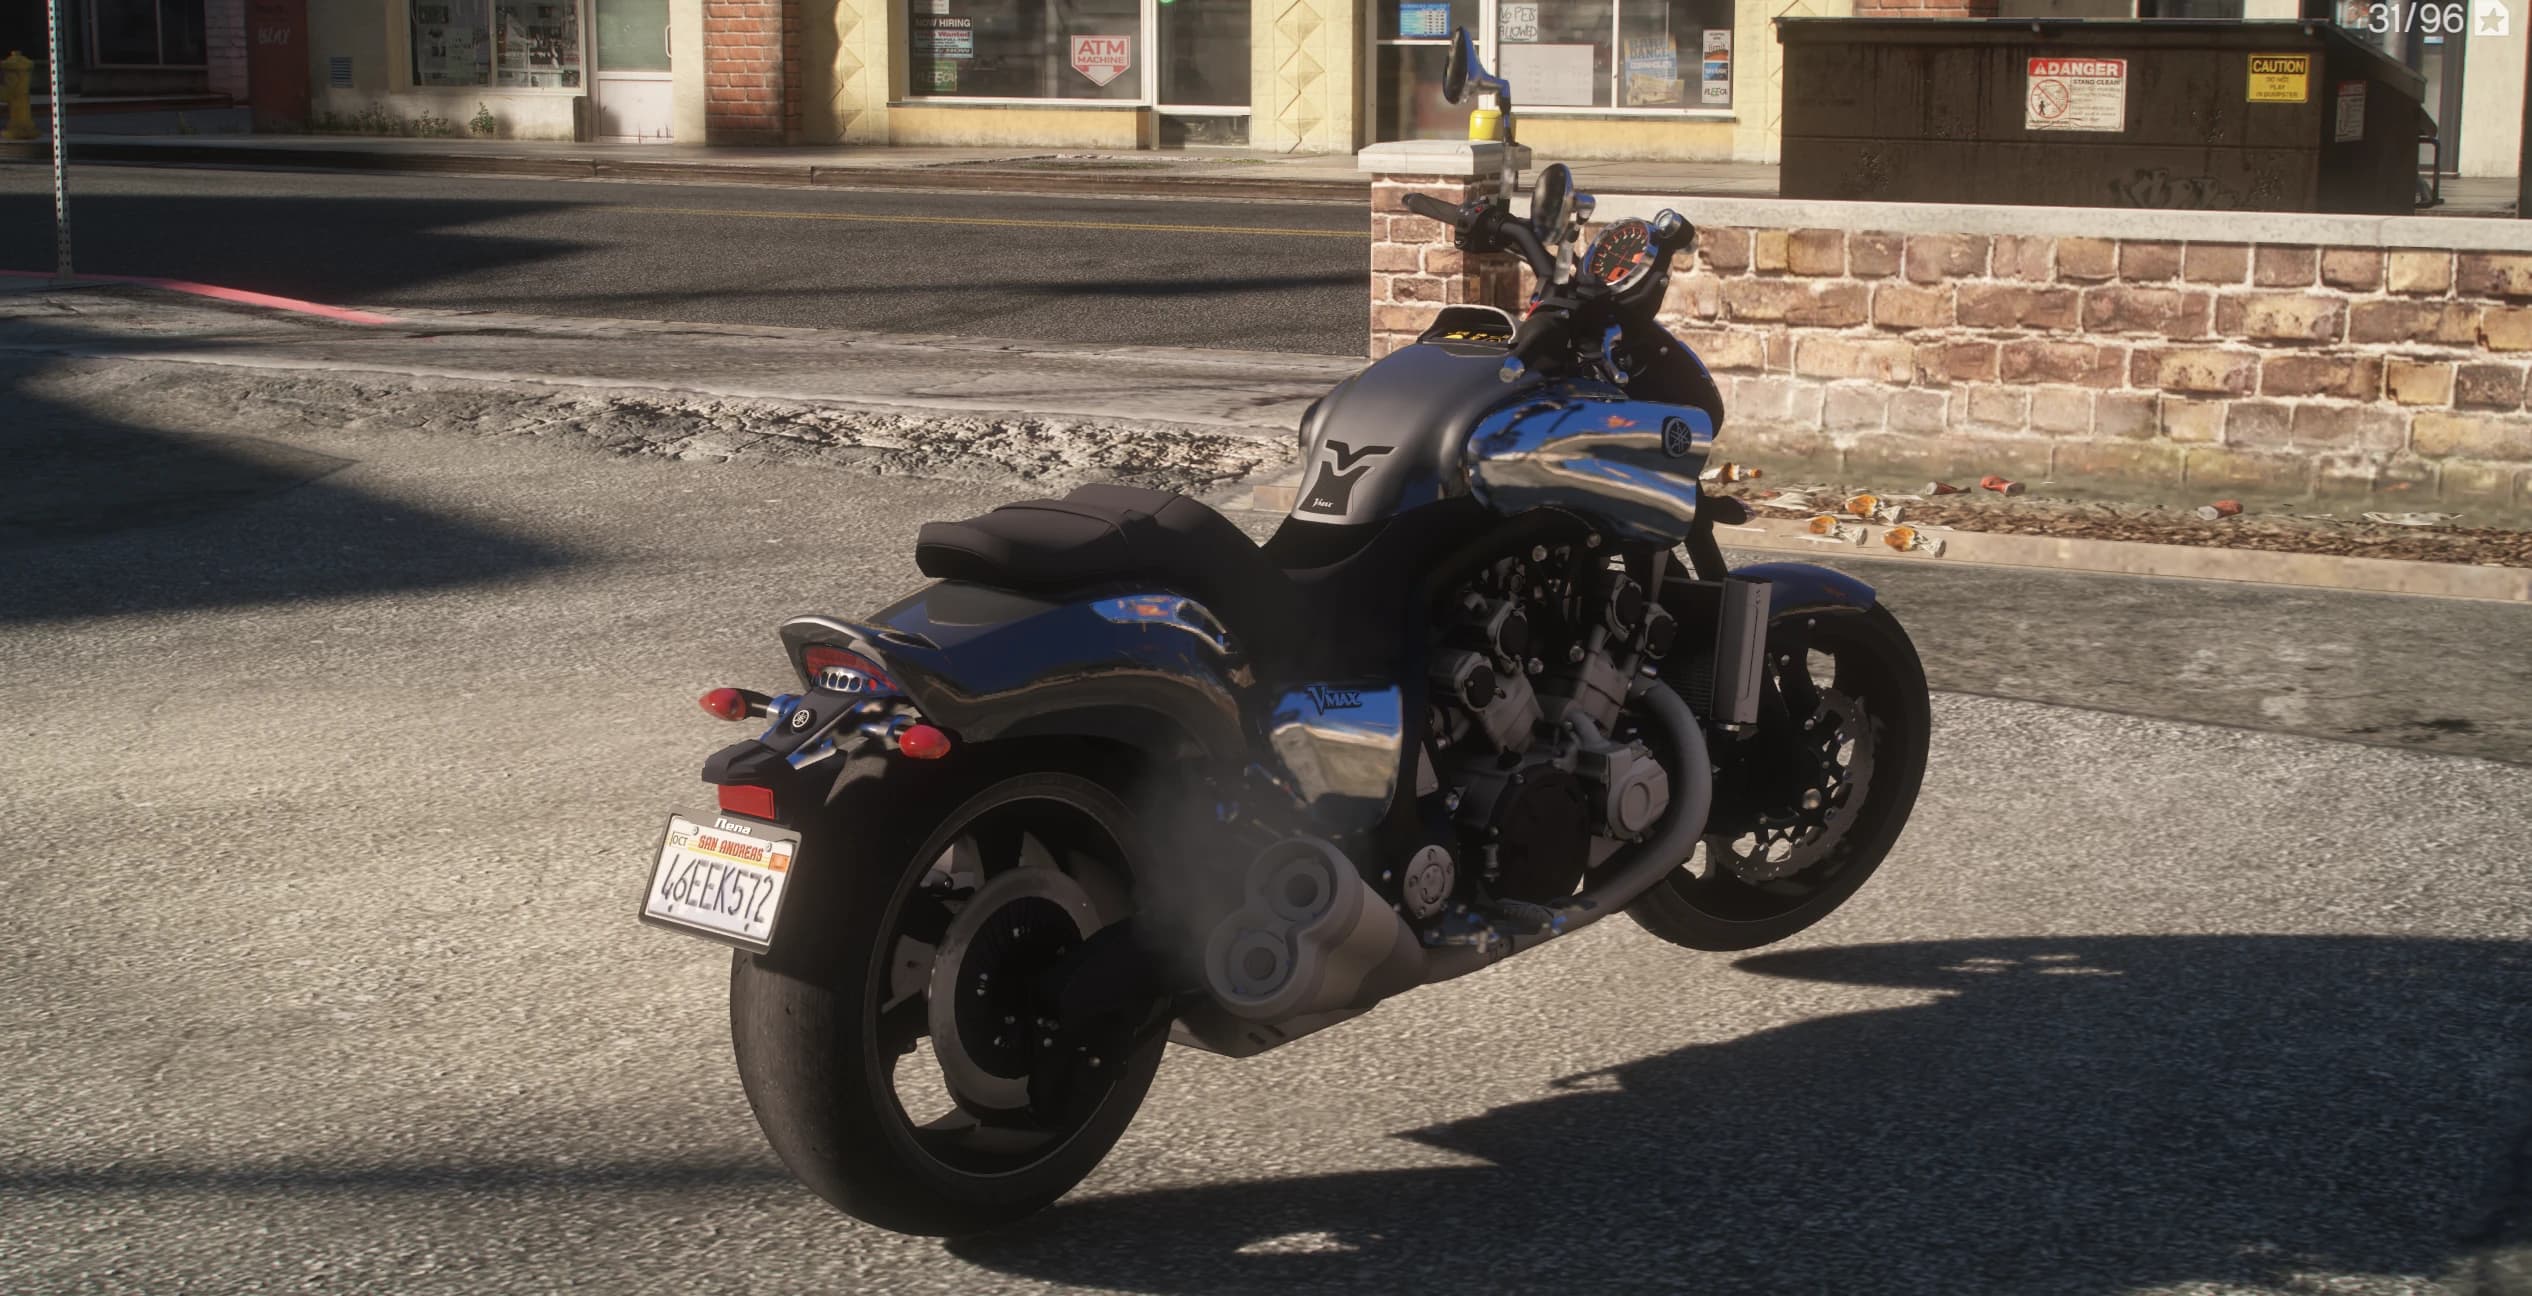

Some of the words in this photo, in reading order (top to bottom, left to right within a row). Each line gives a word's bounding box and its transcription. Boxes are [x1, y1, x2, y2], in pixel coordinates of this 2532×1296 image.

[939, 18, 971, 28] HIRING
[1078, 39, 1125, 55] ATM
[1077, 56, 1125, 64] MACHINE
[2253, 60, 2305, 73] CAUTION
[2047, 61, 2119, 76] DANGER
[672, 835, 689, 846] OCT
[698, 834, 718, 852] SAN
[719, 839, 764, 862] ANDREAS
[662, 854, 774, 923] 46EEK572
